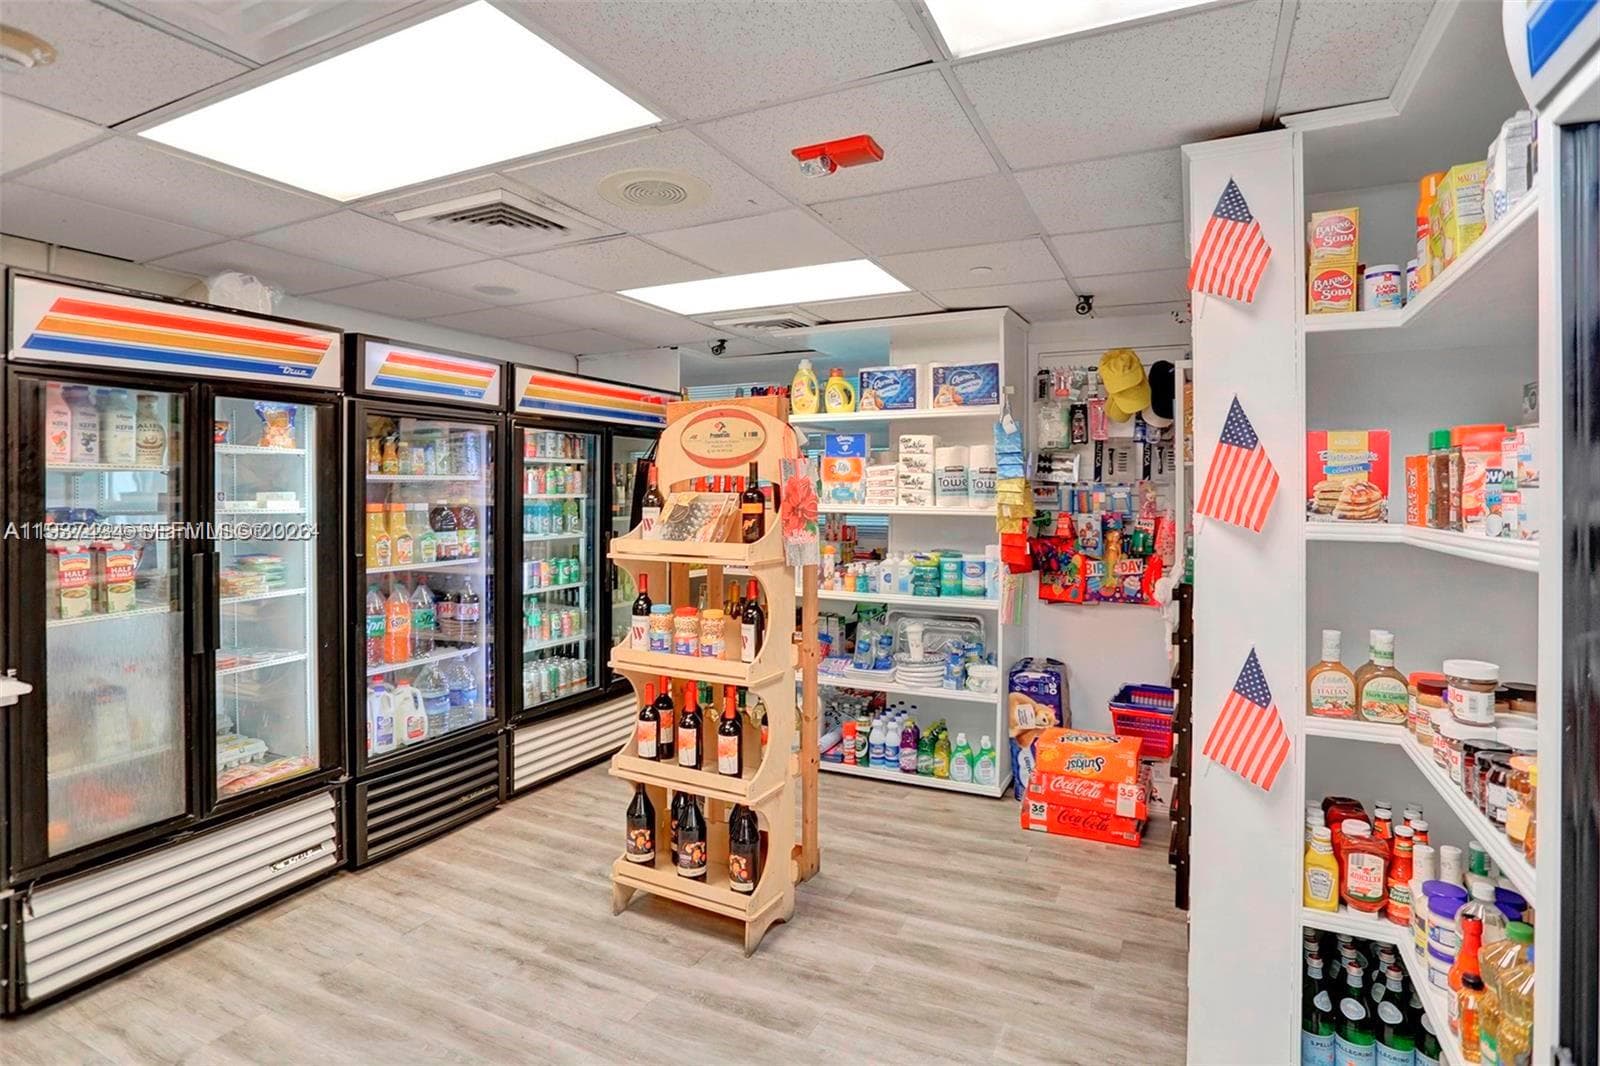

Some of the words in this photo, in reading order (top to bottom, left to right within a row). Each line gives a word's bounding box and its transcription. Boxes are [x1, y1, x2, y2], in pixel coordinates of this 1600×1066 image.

[1316, 221, 1351, 239] BAKING
[1322, 233, 1354, 247] SODA
[1313, 274, 1349, 292] BAKING
[1320, 288, 1352, 301] SODA
[64, 569, 88, 579] HALF
[111, 566, 132, 575] HALF
[1318, 687, 1349, 696] ITALIAN
[1065, 756, 1105, 773] Sunkist
[1050, 775, 1105, 799] Coca-Cola
[1119, 787, 1135, 798] 35
[1031, 803, 1045, 813] 35
